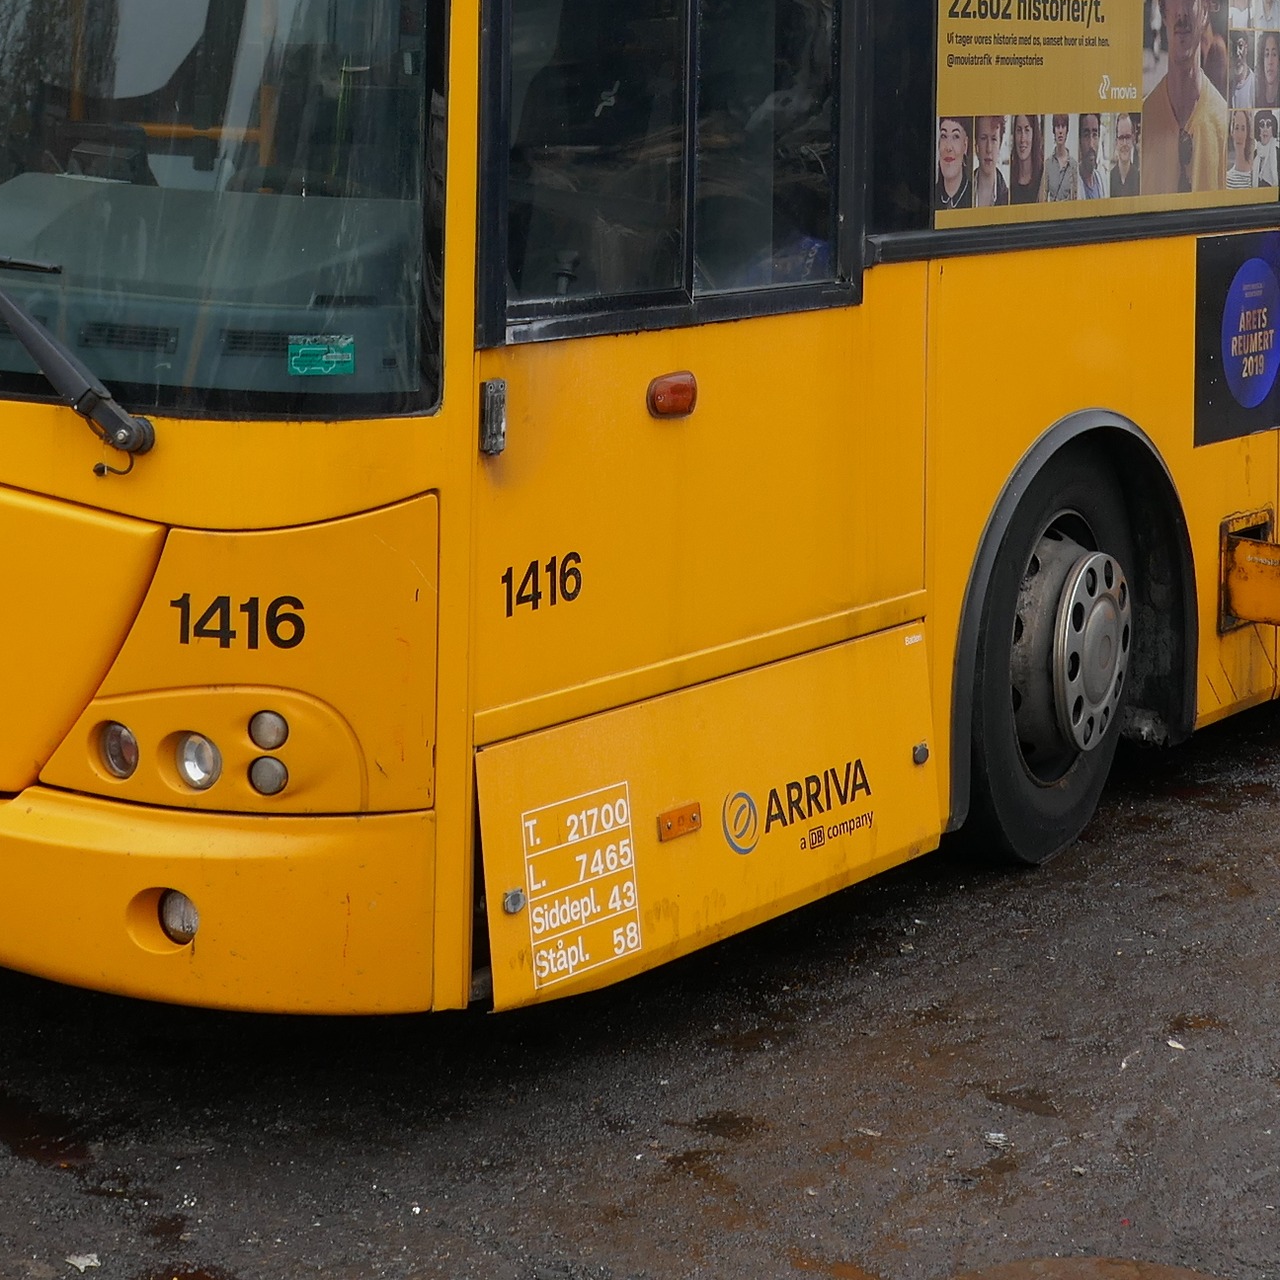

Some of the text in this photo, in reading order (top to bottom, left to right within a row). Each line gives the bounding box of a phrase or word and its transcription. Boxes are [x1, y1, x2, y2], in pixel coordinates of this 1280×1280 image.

[947, 54, 1044, 67] @moviatrafik #movingstories
[955, 35, 973, 47] tager
[974, 36, 992, 45] vores
[993, 33, 1017, 45] historie
[1018, 35, 1032, 45] med
[1085, 36, 1097, 46] skal
[1110, 84, 1137, 99] movia
[1231, 329, 1274, 357] REUMERT
[1242, 354, 1265, 378] 2019
[501, 551, 582, 618] 1416
[170, 593, 305, 649] 1416
[765, 758, 872, 834] ARRIVA
[524, 798, 627, 847] T. 21700
[800, 811, 874, 850] a DB company
[529, 839, 632, 891] L. 7465
[532, 881, 635, 934] Siddepl. 43
[535, 922, 639, 978] Ståpl. 58
